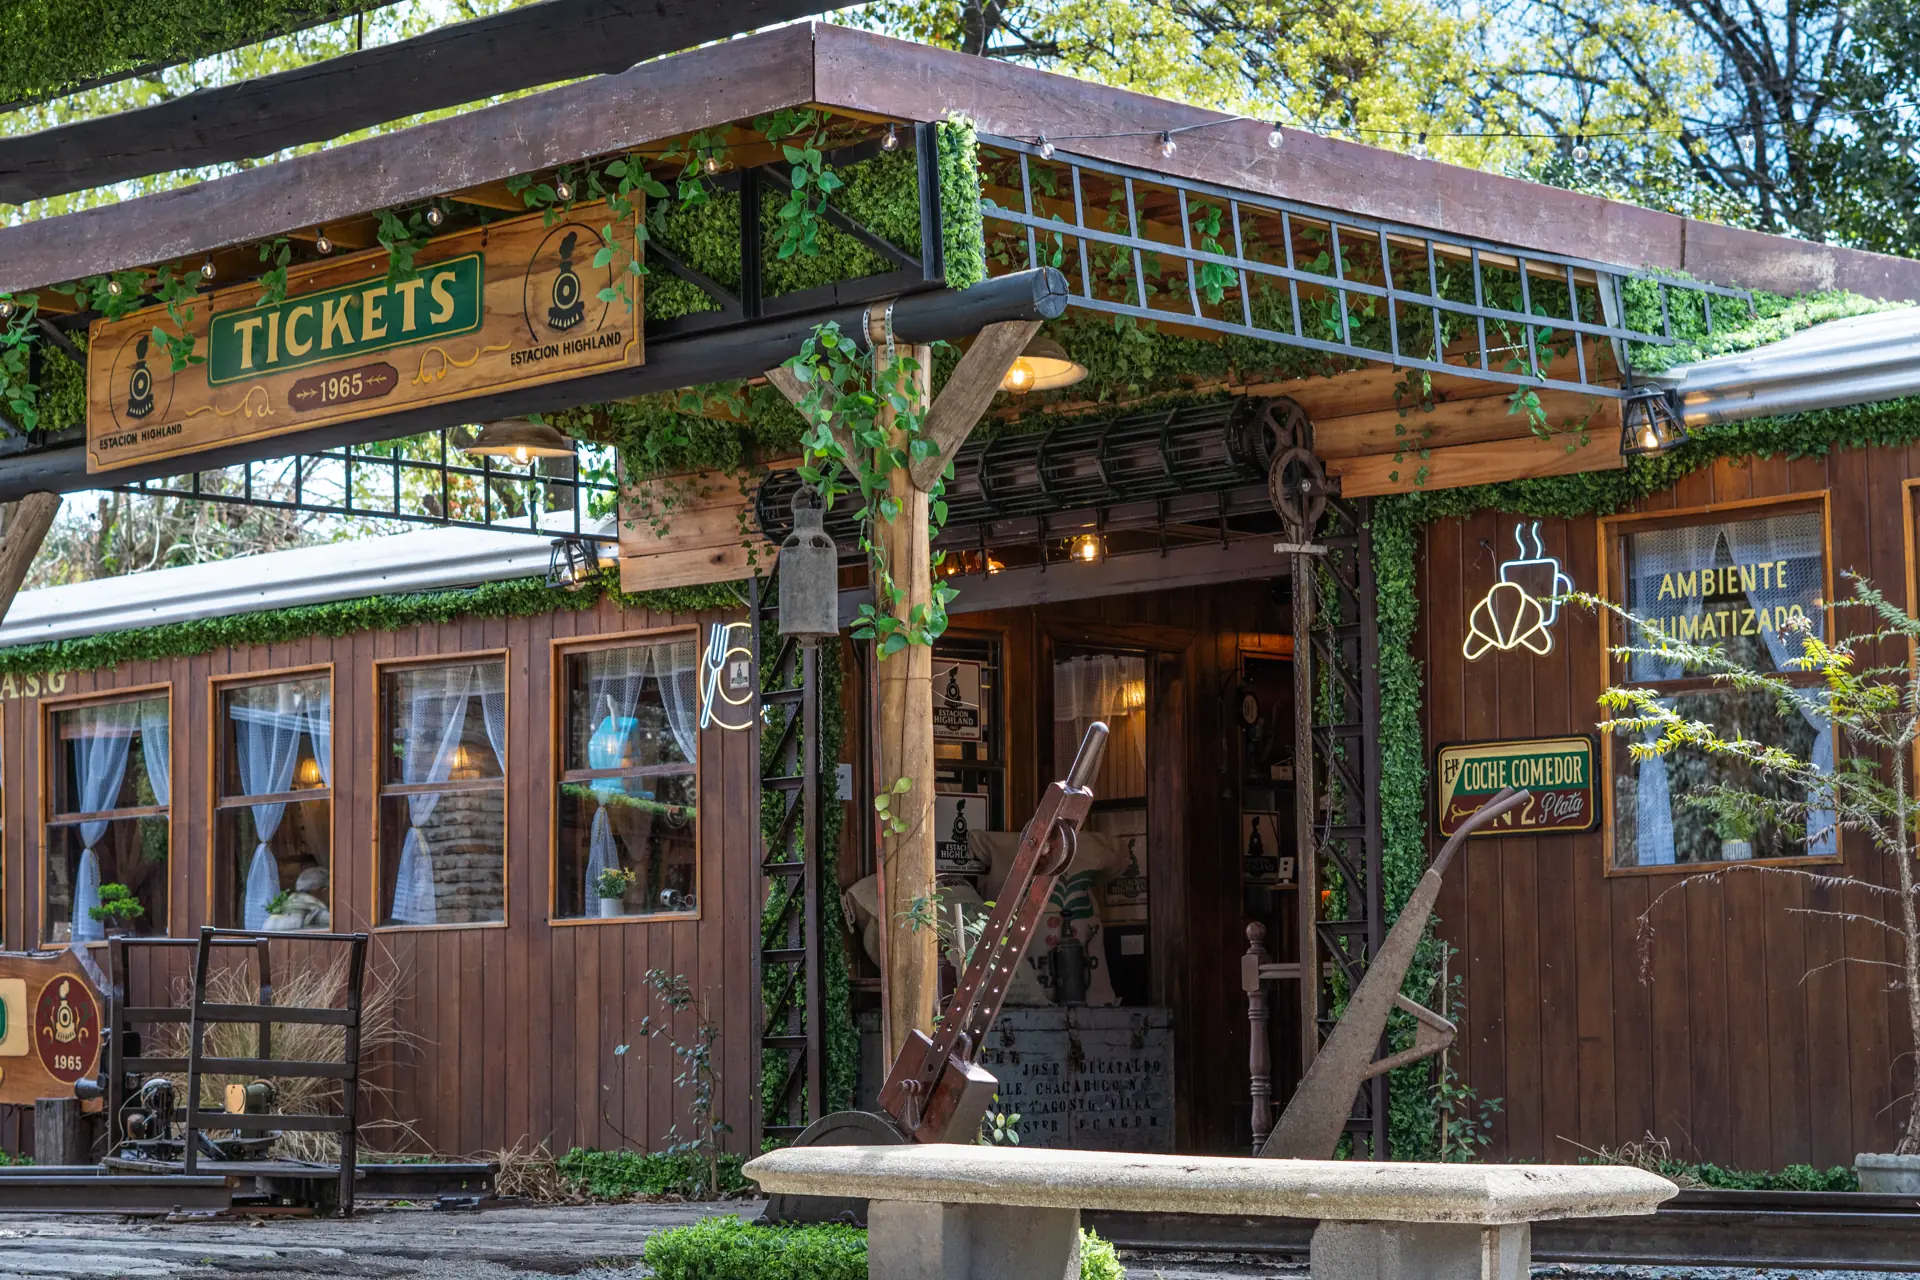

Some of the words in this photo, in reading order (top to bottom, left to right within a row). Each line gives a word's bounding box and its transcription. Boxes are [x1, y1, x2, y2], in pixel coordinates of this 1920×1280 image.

[234, 271, 456, 369] TICKETS
[510, 344, 559, 366] ESTACION
[563, 331, 622, 355] HIGHLAND
[320, 372, 364, 402] 1965
[99, 432, 138, 450] ESTACION
[141, 423, 182, 441] HIGHLAND
[1657, 560, 1788, 600] AMBIENTE
[934, 715, 974, 726] HIGHLAND
[938, 709, 969, 718] ESTACION
[1464, 760, 1507, 790] COCHE
[1512, 755, 1583, 788] COMEDOR
[1539, 791, 1584, 824] Plata
[941, 850, 967, 859] HIGHL
[946, 843, 967, 851] ESTACI
[1112, 884, 1147, 893] HIGHLAN
[54, 1054, 82, 1071] 1965
